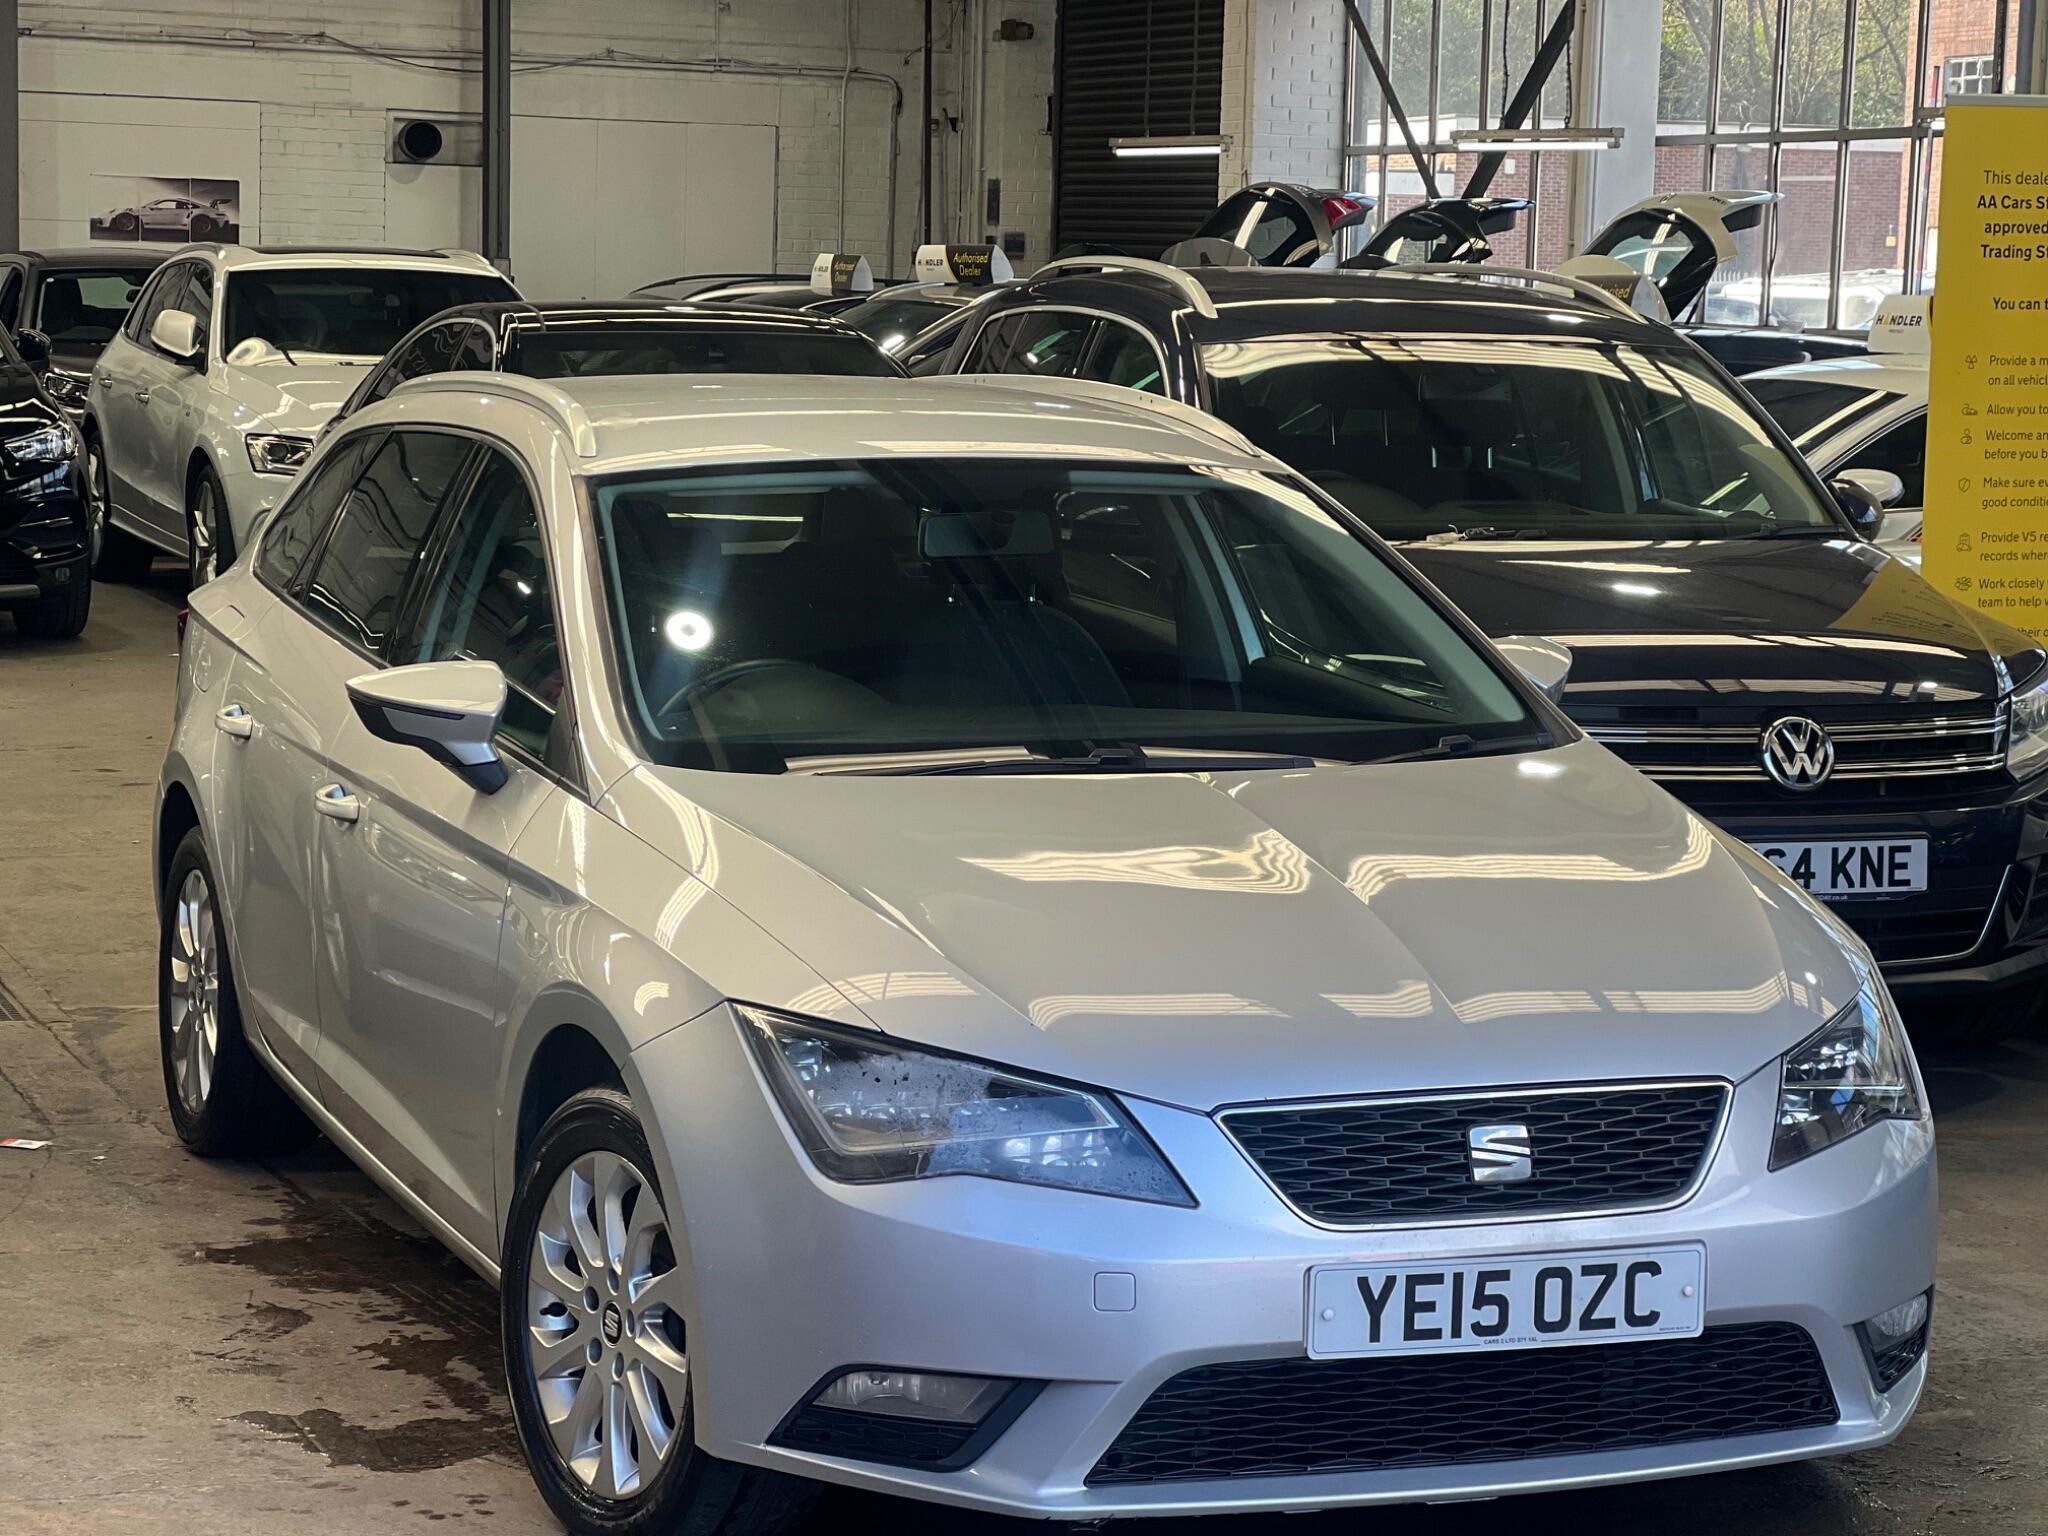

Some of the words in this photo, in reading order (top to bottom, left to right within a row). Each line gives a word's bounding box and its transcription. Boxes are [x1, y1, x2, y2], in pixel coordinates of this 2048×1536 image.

[1984, 170, 2011, 185] This
[1977, 195, 1997, 209] AA
[2001, 195, 2032, 209] Cars
[1984, 220, 2048, 236] approved
[953, 252, 989, 264] Authorised
[1981, 244, 2032, 261] Trading
[960, 264, 981, 276] Dealer
[1993, 297, 2015, 310] You
[2018, 300, 2040, 310] can
[1989, 354, 2027, 366] Provide
[2030, 357, 2036, 366] a
[1988, 377, 2000, 386] on
[2003, 374, 2015, 386] all
[1987, 403, 2014, 415] Allow
[2016, 406, 2036, 417] you
[2039, 404, 2048, 415] to
[1985, 429, 2033, 441] Welcome
[1984, 448, 2017, 459] before
[2019, 450, 2038, 461] you
[1983, 477, 2010, 488] Make
[2012, 479, 2035, 488] sure
[1982, 496, 2007, 510] good
[2009, 496, 2048, 507] conditi
[1981, 531, 2019, 543] Provide
[2022, 531, 2037, 542] V5
[1980, 550, 2019, 561] records
[2021, 549, 2048, 560] wher
[1979, 578, 2007, 590] Work
[2008, 578, 2044, 591] closely
[1978, 597, 2003, 608] team
[2006, 596, 2016, 607] to
[2019, 595, 2042, 608] help
[1830, 845, 1912, 889] KNE
[1357, 1268, 1511, 1343] YE15
[1533, 1261, 1662, 1334] OZC
